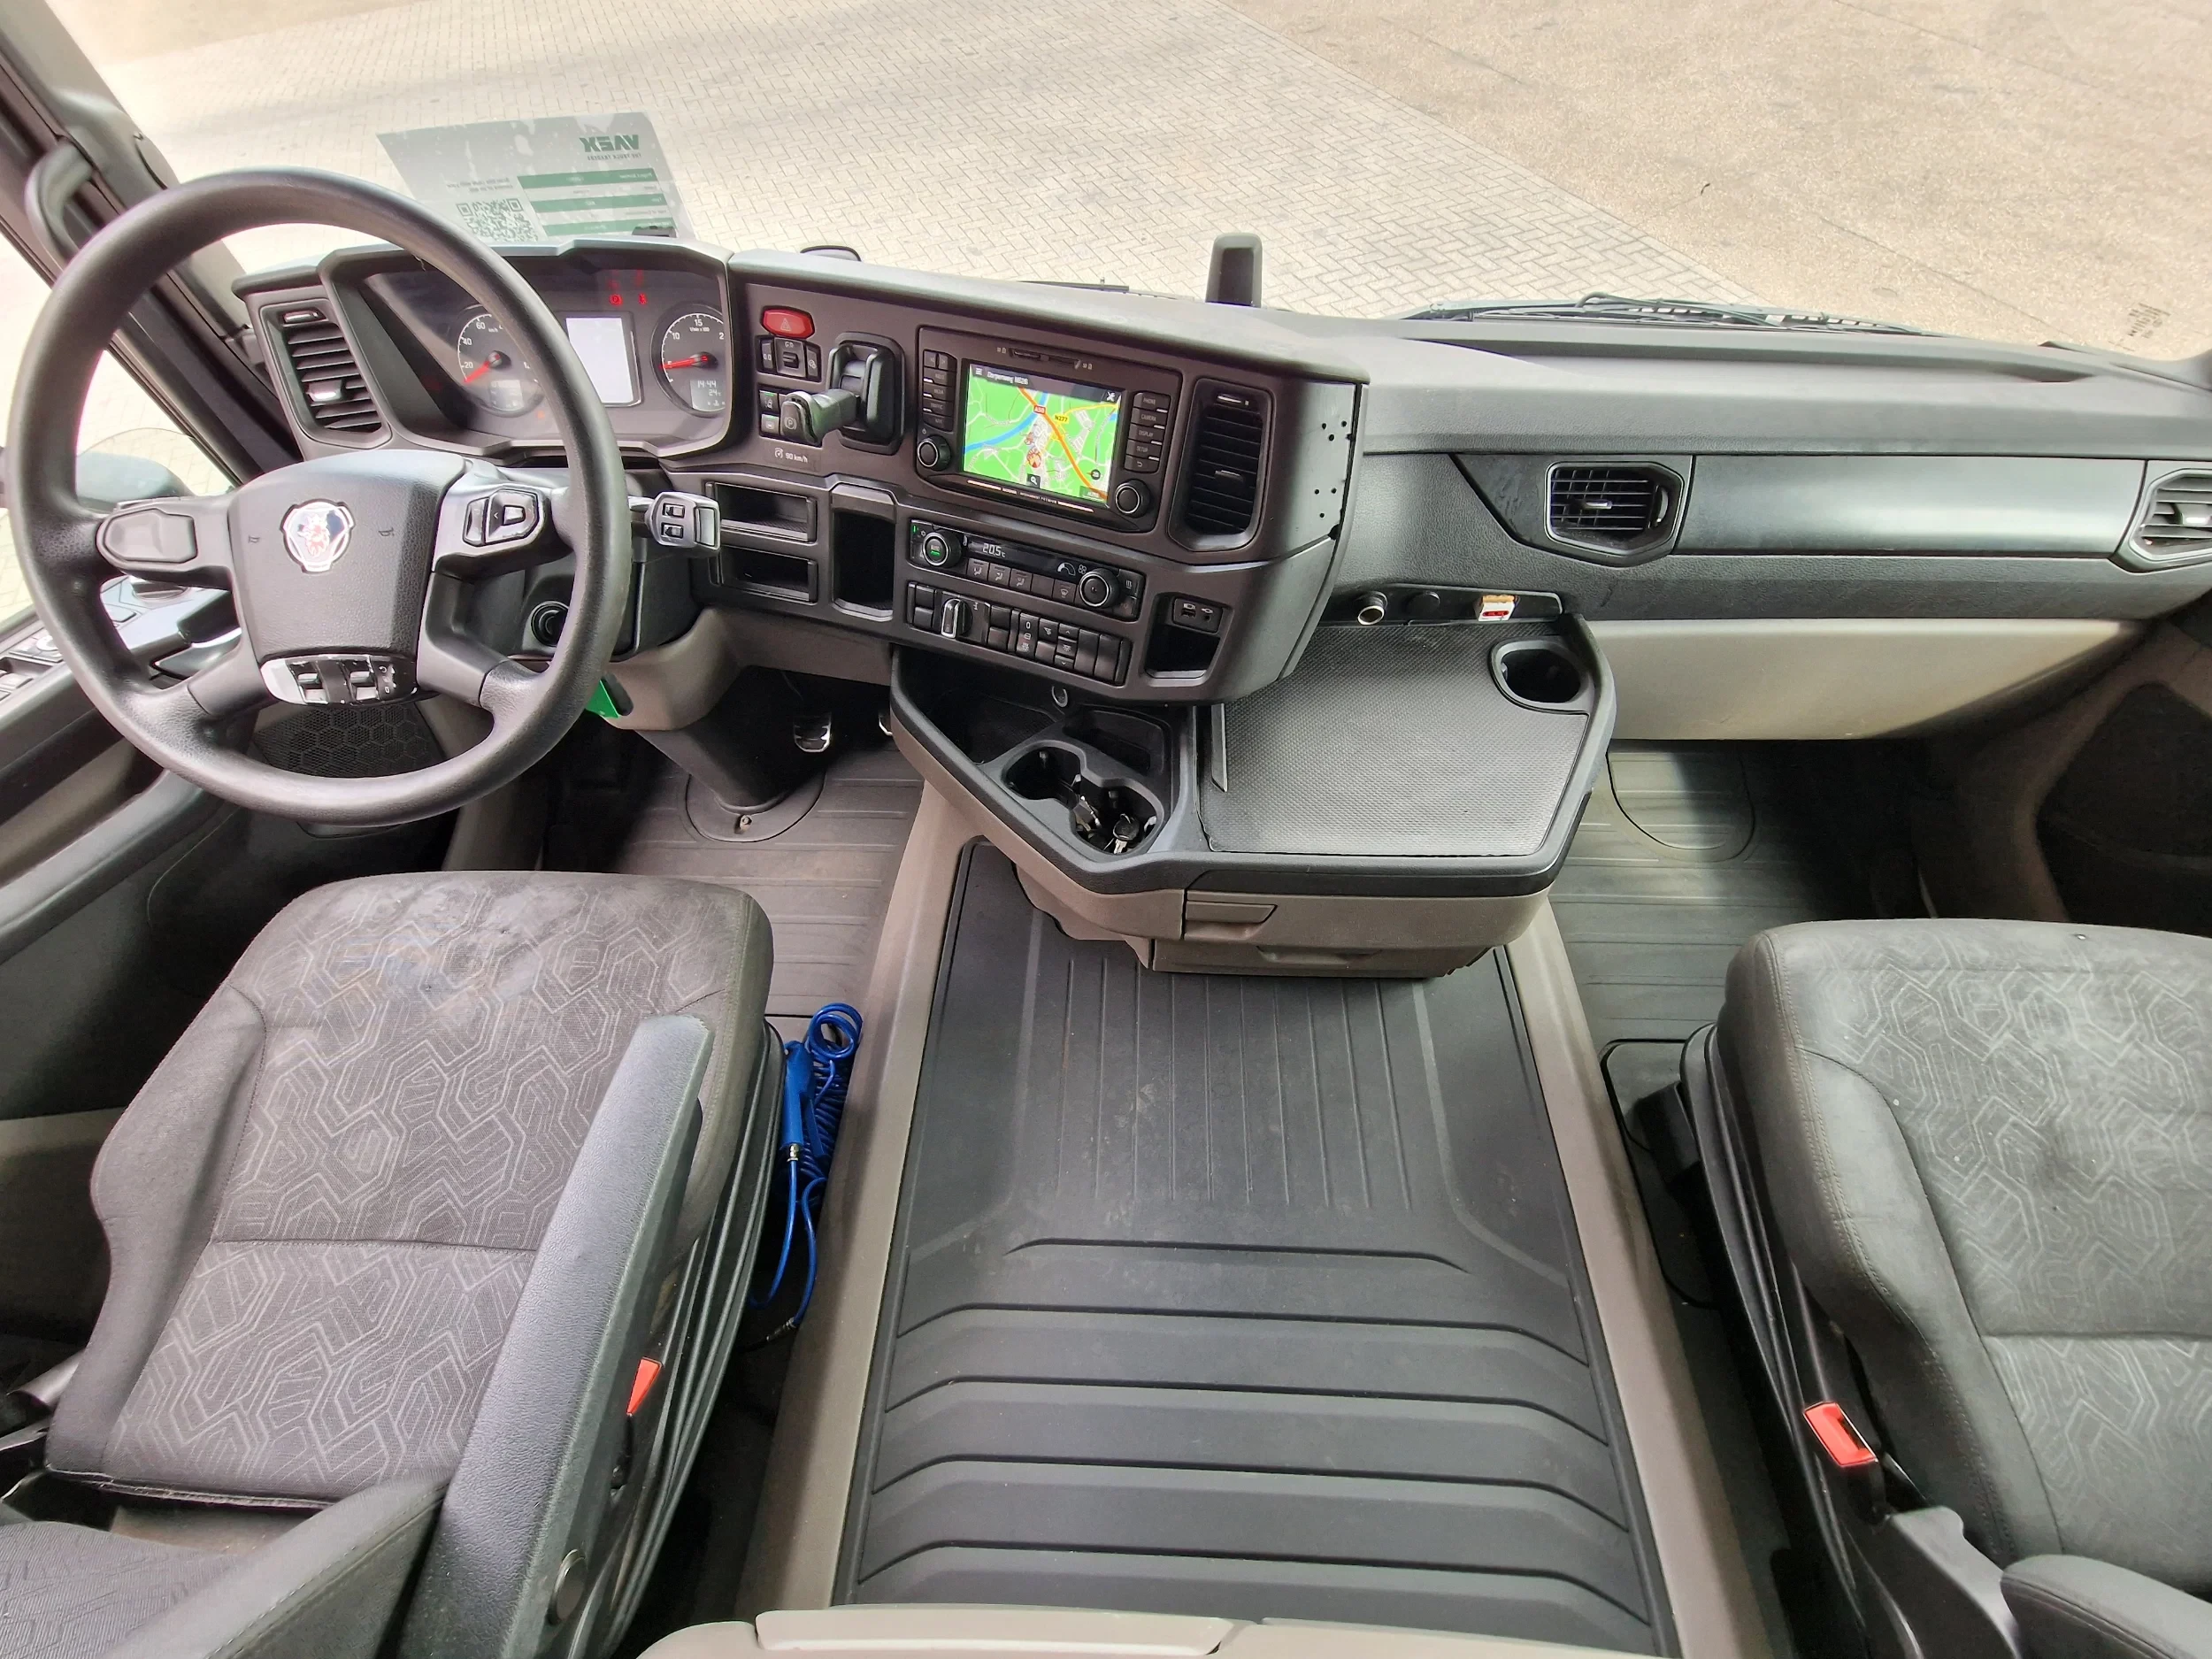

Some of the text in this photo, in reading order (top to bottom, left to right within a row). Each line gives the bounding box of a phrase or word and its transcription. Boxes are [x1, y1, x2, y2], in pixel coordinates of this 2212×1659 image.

[697, 380, 717, 388] 14:44
[1141, 413, 1156, 422] CAMERA
[1138, 429, 1154, 438] DISPLAY
[794, 454, 808, 463] km/h
